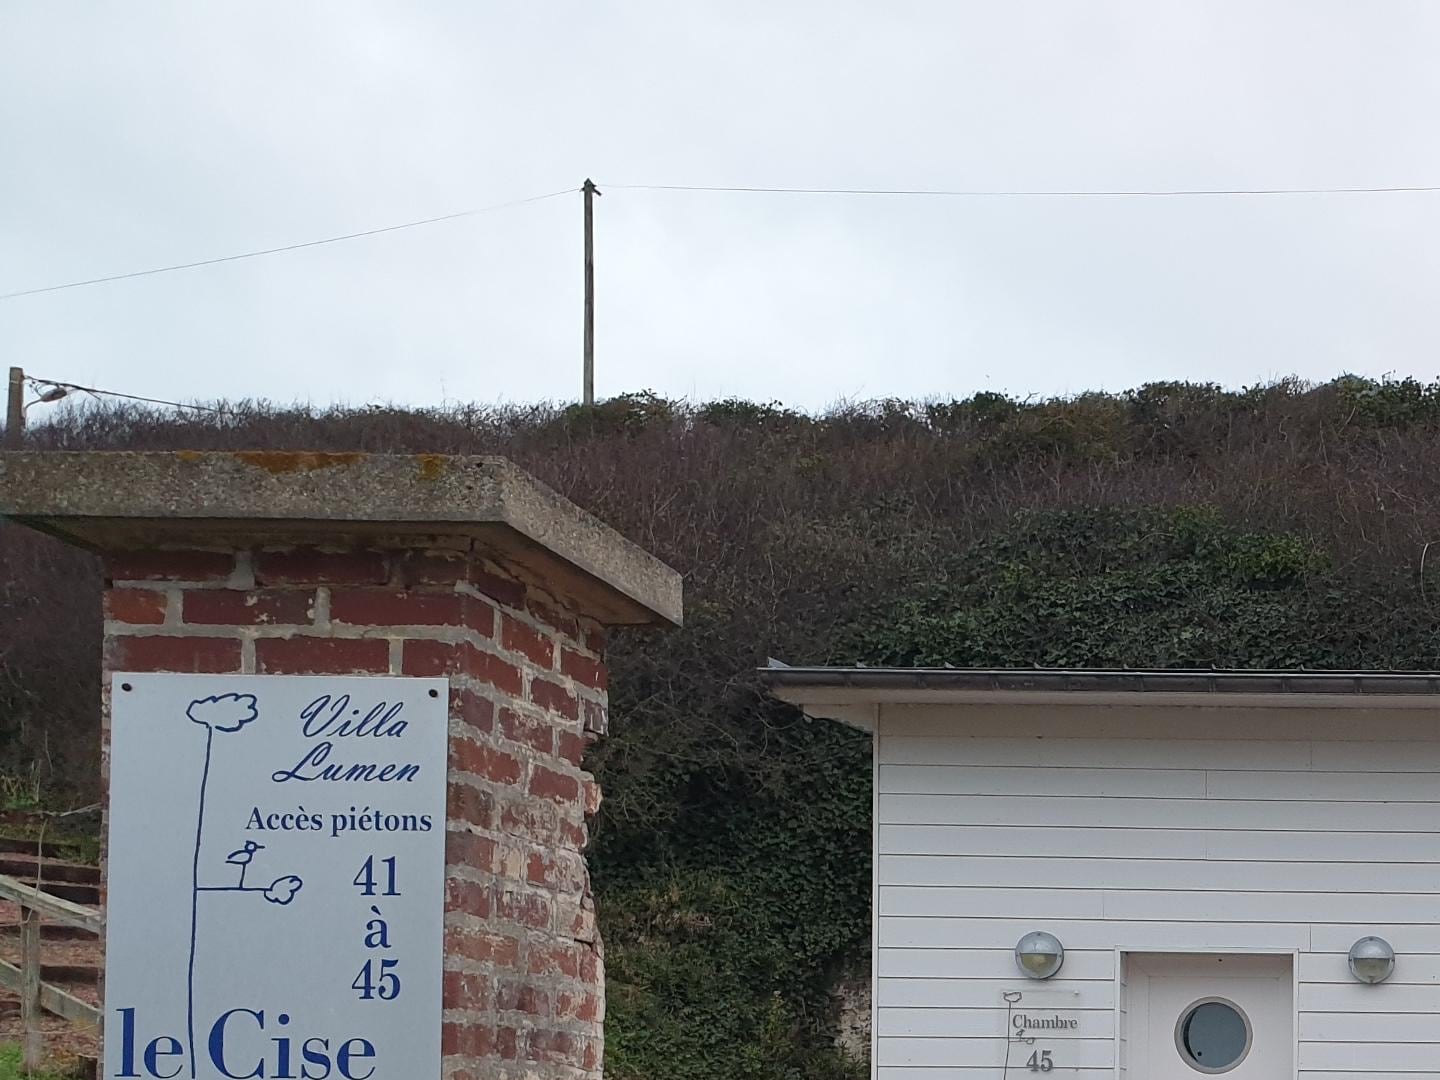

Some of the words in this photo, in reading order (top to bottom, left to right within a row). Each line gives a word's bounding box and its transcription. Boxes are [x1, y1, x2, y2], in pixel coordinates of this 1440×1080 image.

[300, 694, 408, 738] Villa
[271, 742, 420, 783] Lumen
[245, 806, 323, 832] Accès
[331, 807, 432, 837] piétons
[353, 855, 401, 896] 41
[364, 905, 391, 948] à
[351, 958, 401, 1000] 45
[1012, 1014, 1079, 1030] Chambre
[113, 1007, 184, 1079] le
[208, 1008, 376, 1080] Cise
[1026, 1050, 1054, 1073] 45
